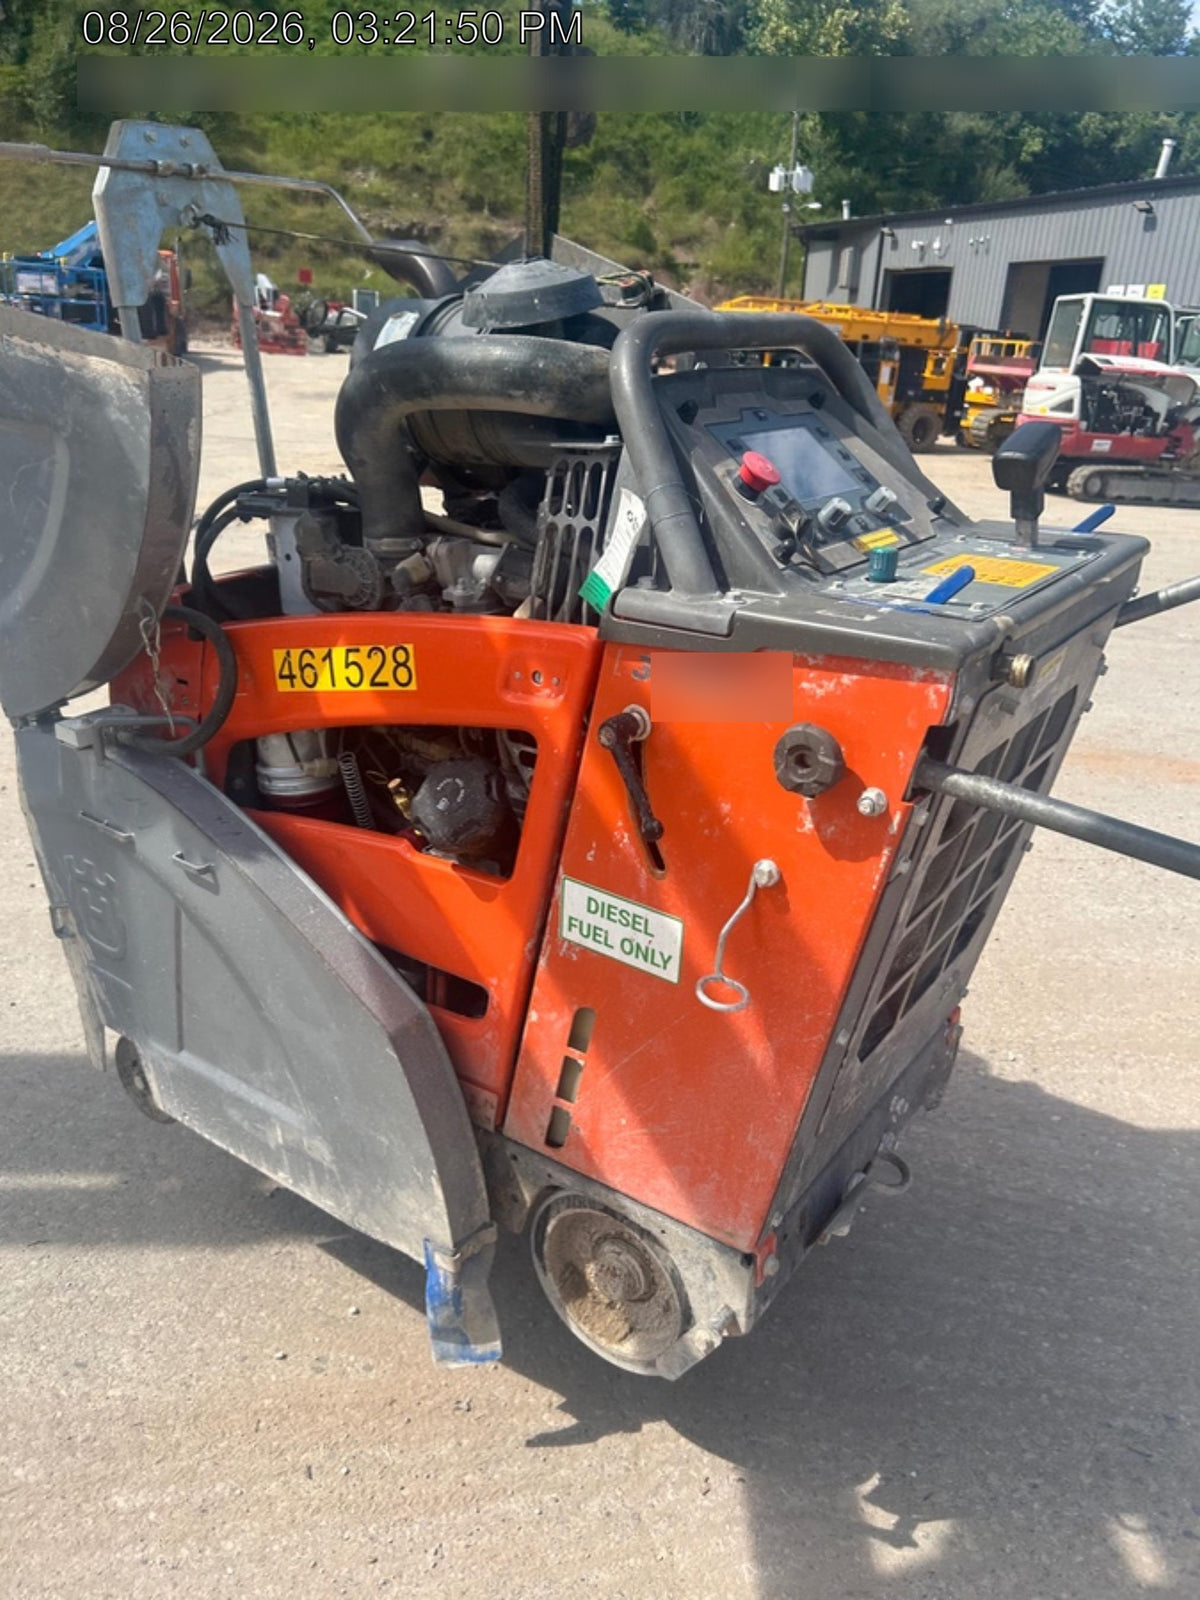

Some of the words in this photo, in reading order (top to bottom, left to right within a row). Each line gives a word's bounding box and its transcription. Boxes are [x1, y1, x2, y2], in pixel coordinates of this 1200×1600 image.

[278, 645, 413, 688] 461528
[586, 896, 655, 938] DIESEL
[567, 915, 614, 950] FUEL
[620, 937, 672, 971] ONLY
